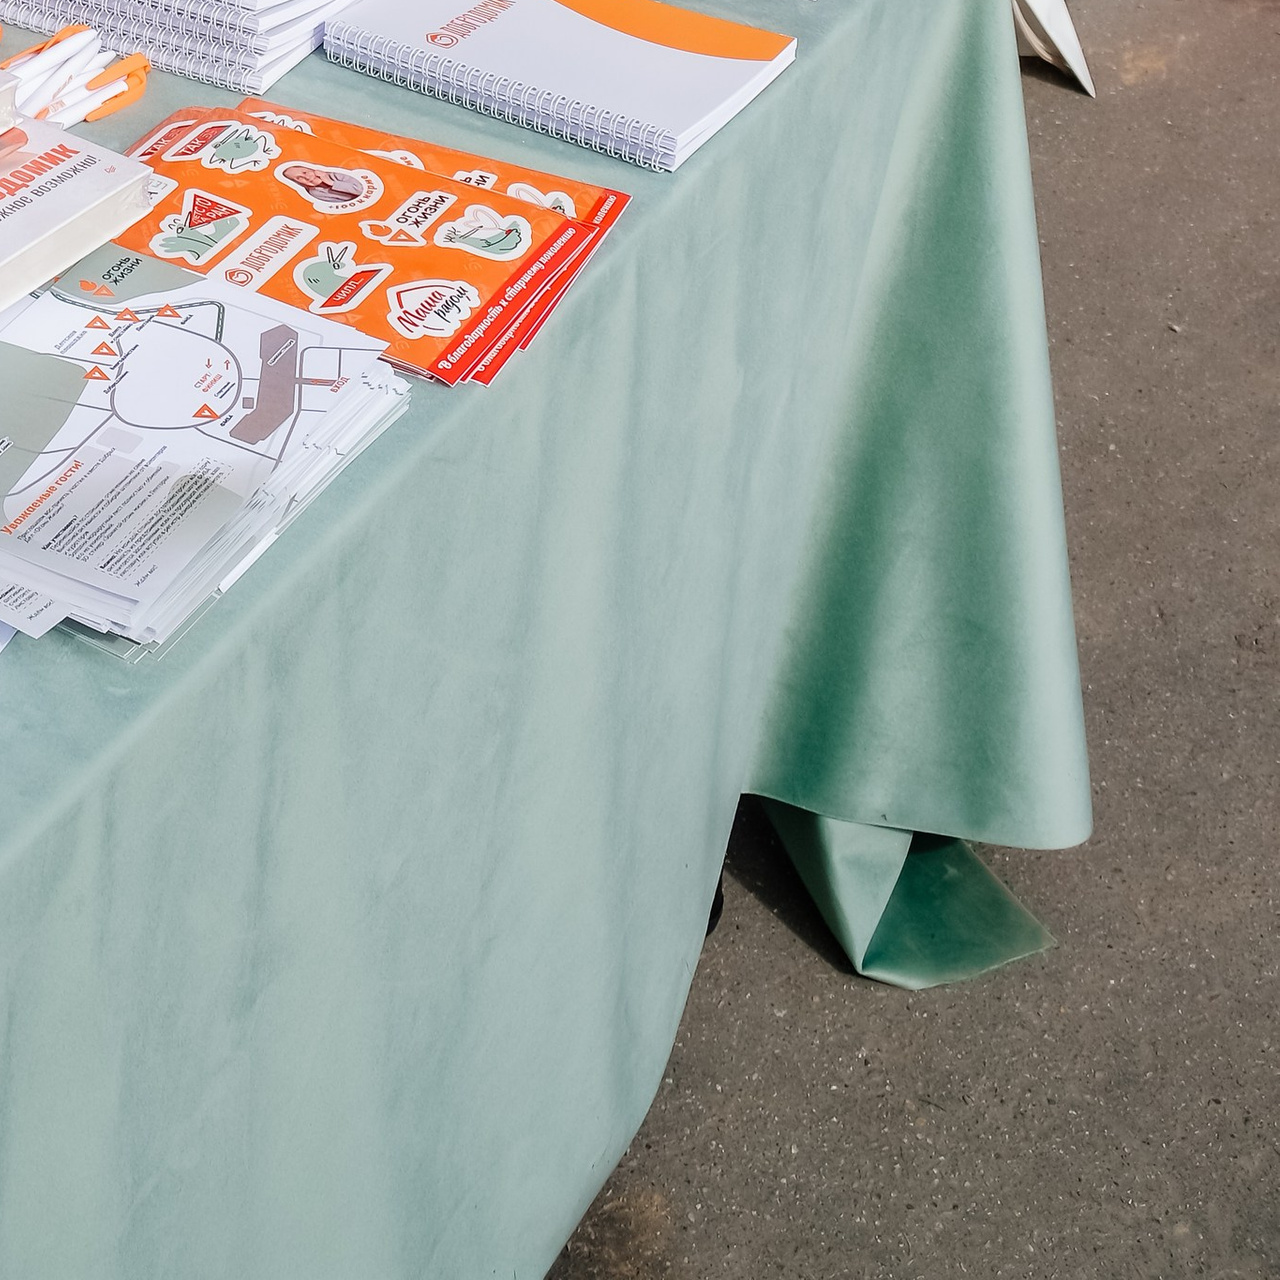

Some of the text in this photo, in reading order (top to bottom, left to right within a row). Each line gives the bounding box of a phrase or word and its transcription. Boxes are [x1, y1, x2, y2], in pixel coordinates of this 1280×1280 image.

[181, 136, 208, 158] ТАК
[31, 153, 103, 203] возможно!
[396, 194, 431, 225] ОГОНЬ
[409, 194, 450, 229] ЖИЗНИ
[247, 223, 303, 273] ДОБРОДОМИК
[102, 256, 131, 281] ОГОНЬ
[109, 257, 143, 286] ЖИЗНИ
[397, 290, 446, 334] Маша
[438, 358, 452, 371] В
[449, 303, 505, 365] благодарность
[500, 298, 509, 309] к
[506, 261, 544, 302] старшему
[541, 226, 577, 270] поколению
[329, 376, 351, 394] ВХОД
[0, 459, 85, 535] Уважаемые гости!
